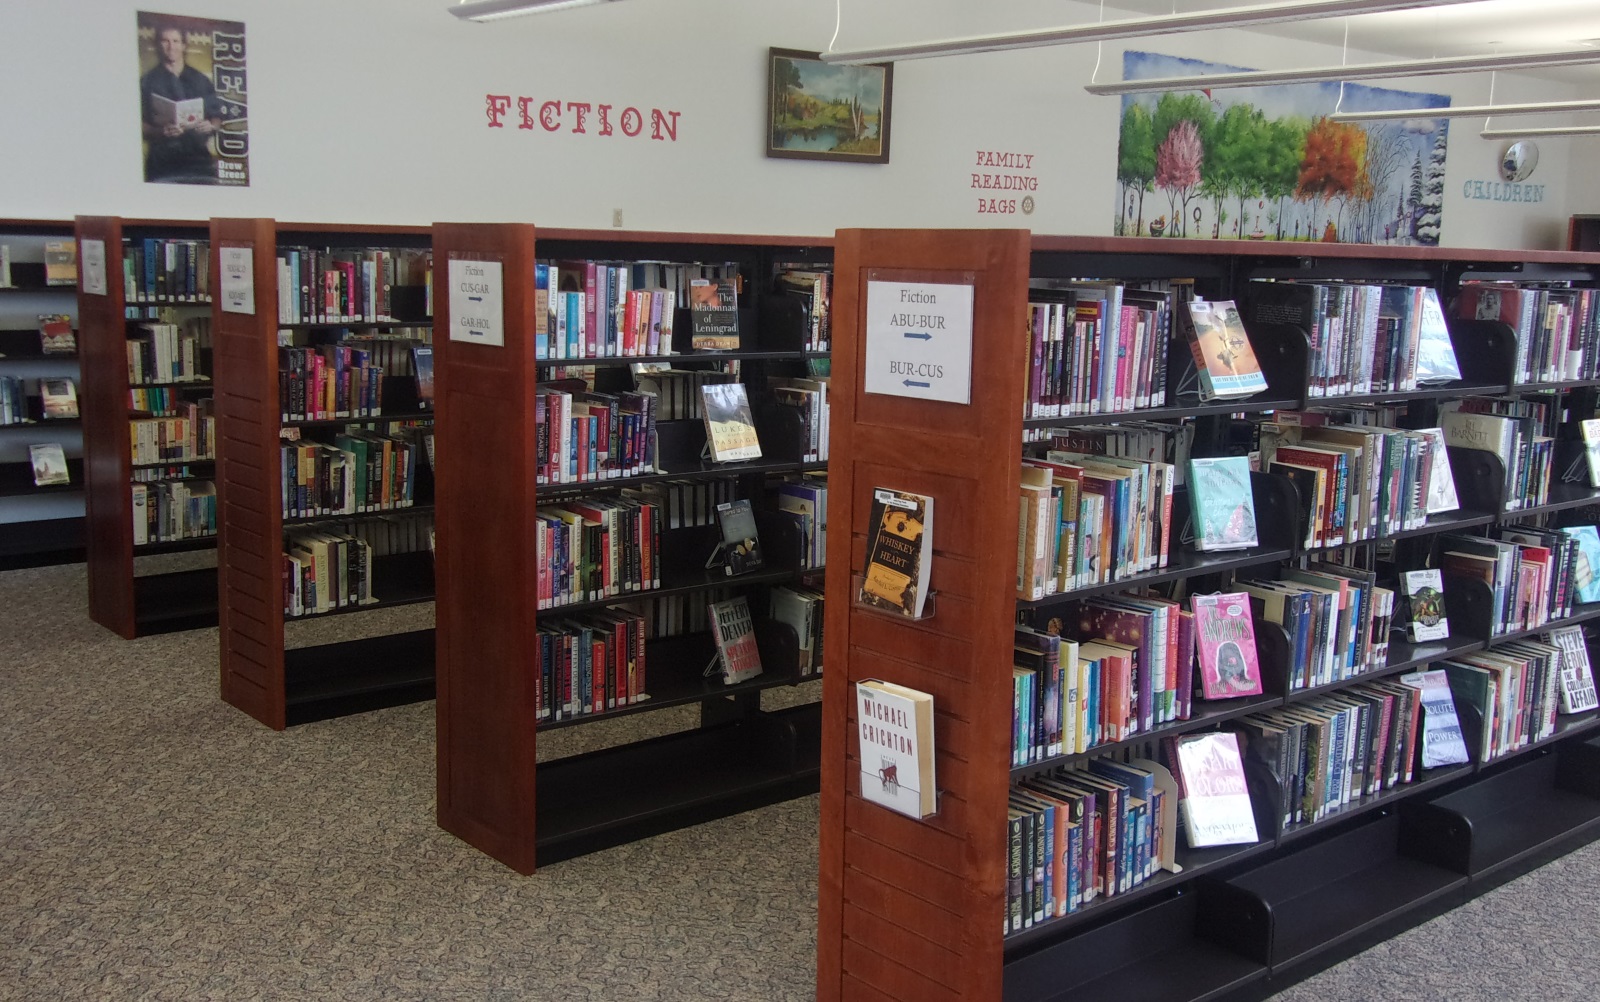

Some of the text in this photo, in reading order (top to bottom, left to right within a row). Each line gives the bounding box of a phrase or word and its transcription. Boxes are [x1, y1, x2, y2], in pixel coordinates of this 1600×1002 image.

[213, 31, 249, 158] READ
[486, 94, 681, 141] FICTION
[218, 160, 242, 170] Drew
[976, 151, 1034, 169] FAMILY
[218, 170, 245, 179] Brees
[971, 174, 1038, 191] READING
[1463, 180, 1545, 202] CHILDREN
[978, 198, 1016, 214] BAGS
[465, 266, 484, 276] Fiction
[461, 283, 489, 294] CUS-GAR
[719, 293, 733, 301] The
[900, 289, 936, 304] Fiction
[695, 303, 736, 312] Madonnas
[461, 317, 490, 329] GAR-HOL
[704, 314, 712, 322] of
[890, 313, 946, 329] ABU-BUR
[696, 324, 737, 334] Leningrad
[1154, 328, 1162, 374] COURAGEOUS
[889, 361, 943, 378] BUR-CUS
[1054, 437, 1103, 450] JUSTIN
[880, 535, 915, 555] WHISKEY
[881, 550, 907, 568] HEART
[720, 619, 752, 642] DEAVER
[1204, 617, 1250, 642] ANDREWS
[1555, 631, 1584, 652] STEVE
[1562, 649, 1587, 670] BERRY
[1564, 671, 1573, 681] THE
[1570, 688, 1597, 710] AFFAIR
[864, 699, 908, 729] MICHAEL
[1383, 700, 1391, 724] DAVID
[1425, 703, 1454, 715] SOLUTE
[863, 723, 913, 756] CRICHTON
[1333, 715, 1346, 775] DAVID BALDACCI
[1428, 731, 1459, 743] POWER
[1109, 817, 1117, 848] ANDREWS
[1011, 846, 1022, 878] ANDREWS
